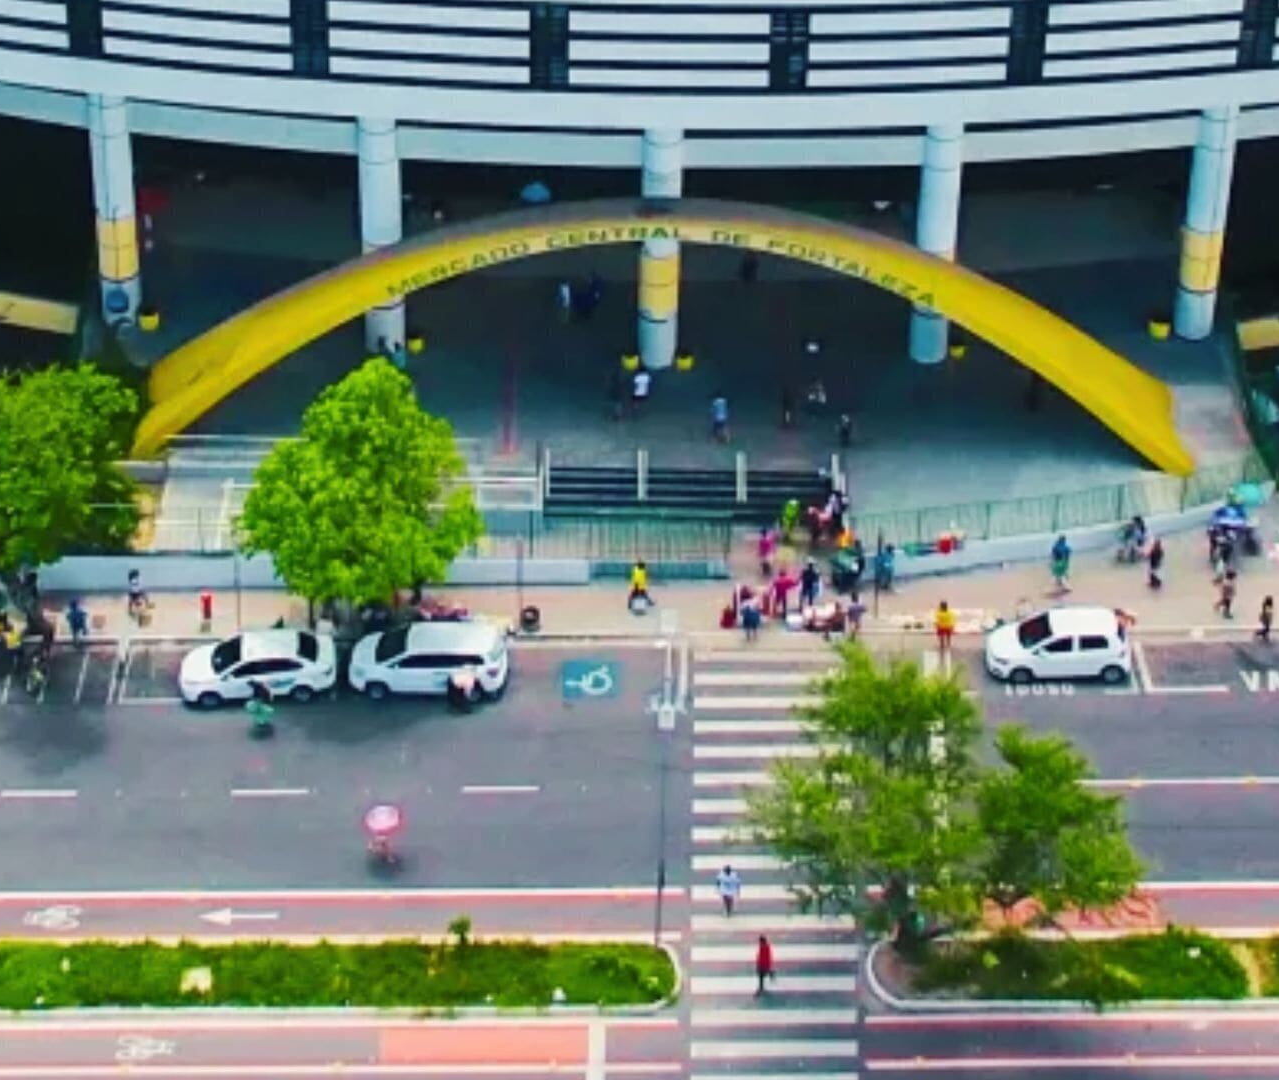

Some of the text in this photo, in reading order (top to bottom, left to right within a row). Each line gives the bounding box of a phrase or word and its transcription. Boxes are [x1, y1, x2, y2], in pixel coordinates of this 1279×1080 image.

[385, 225, 935, 306] MERCADO CENTRAL DE FORTALEZA
